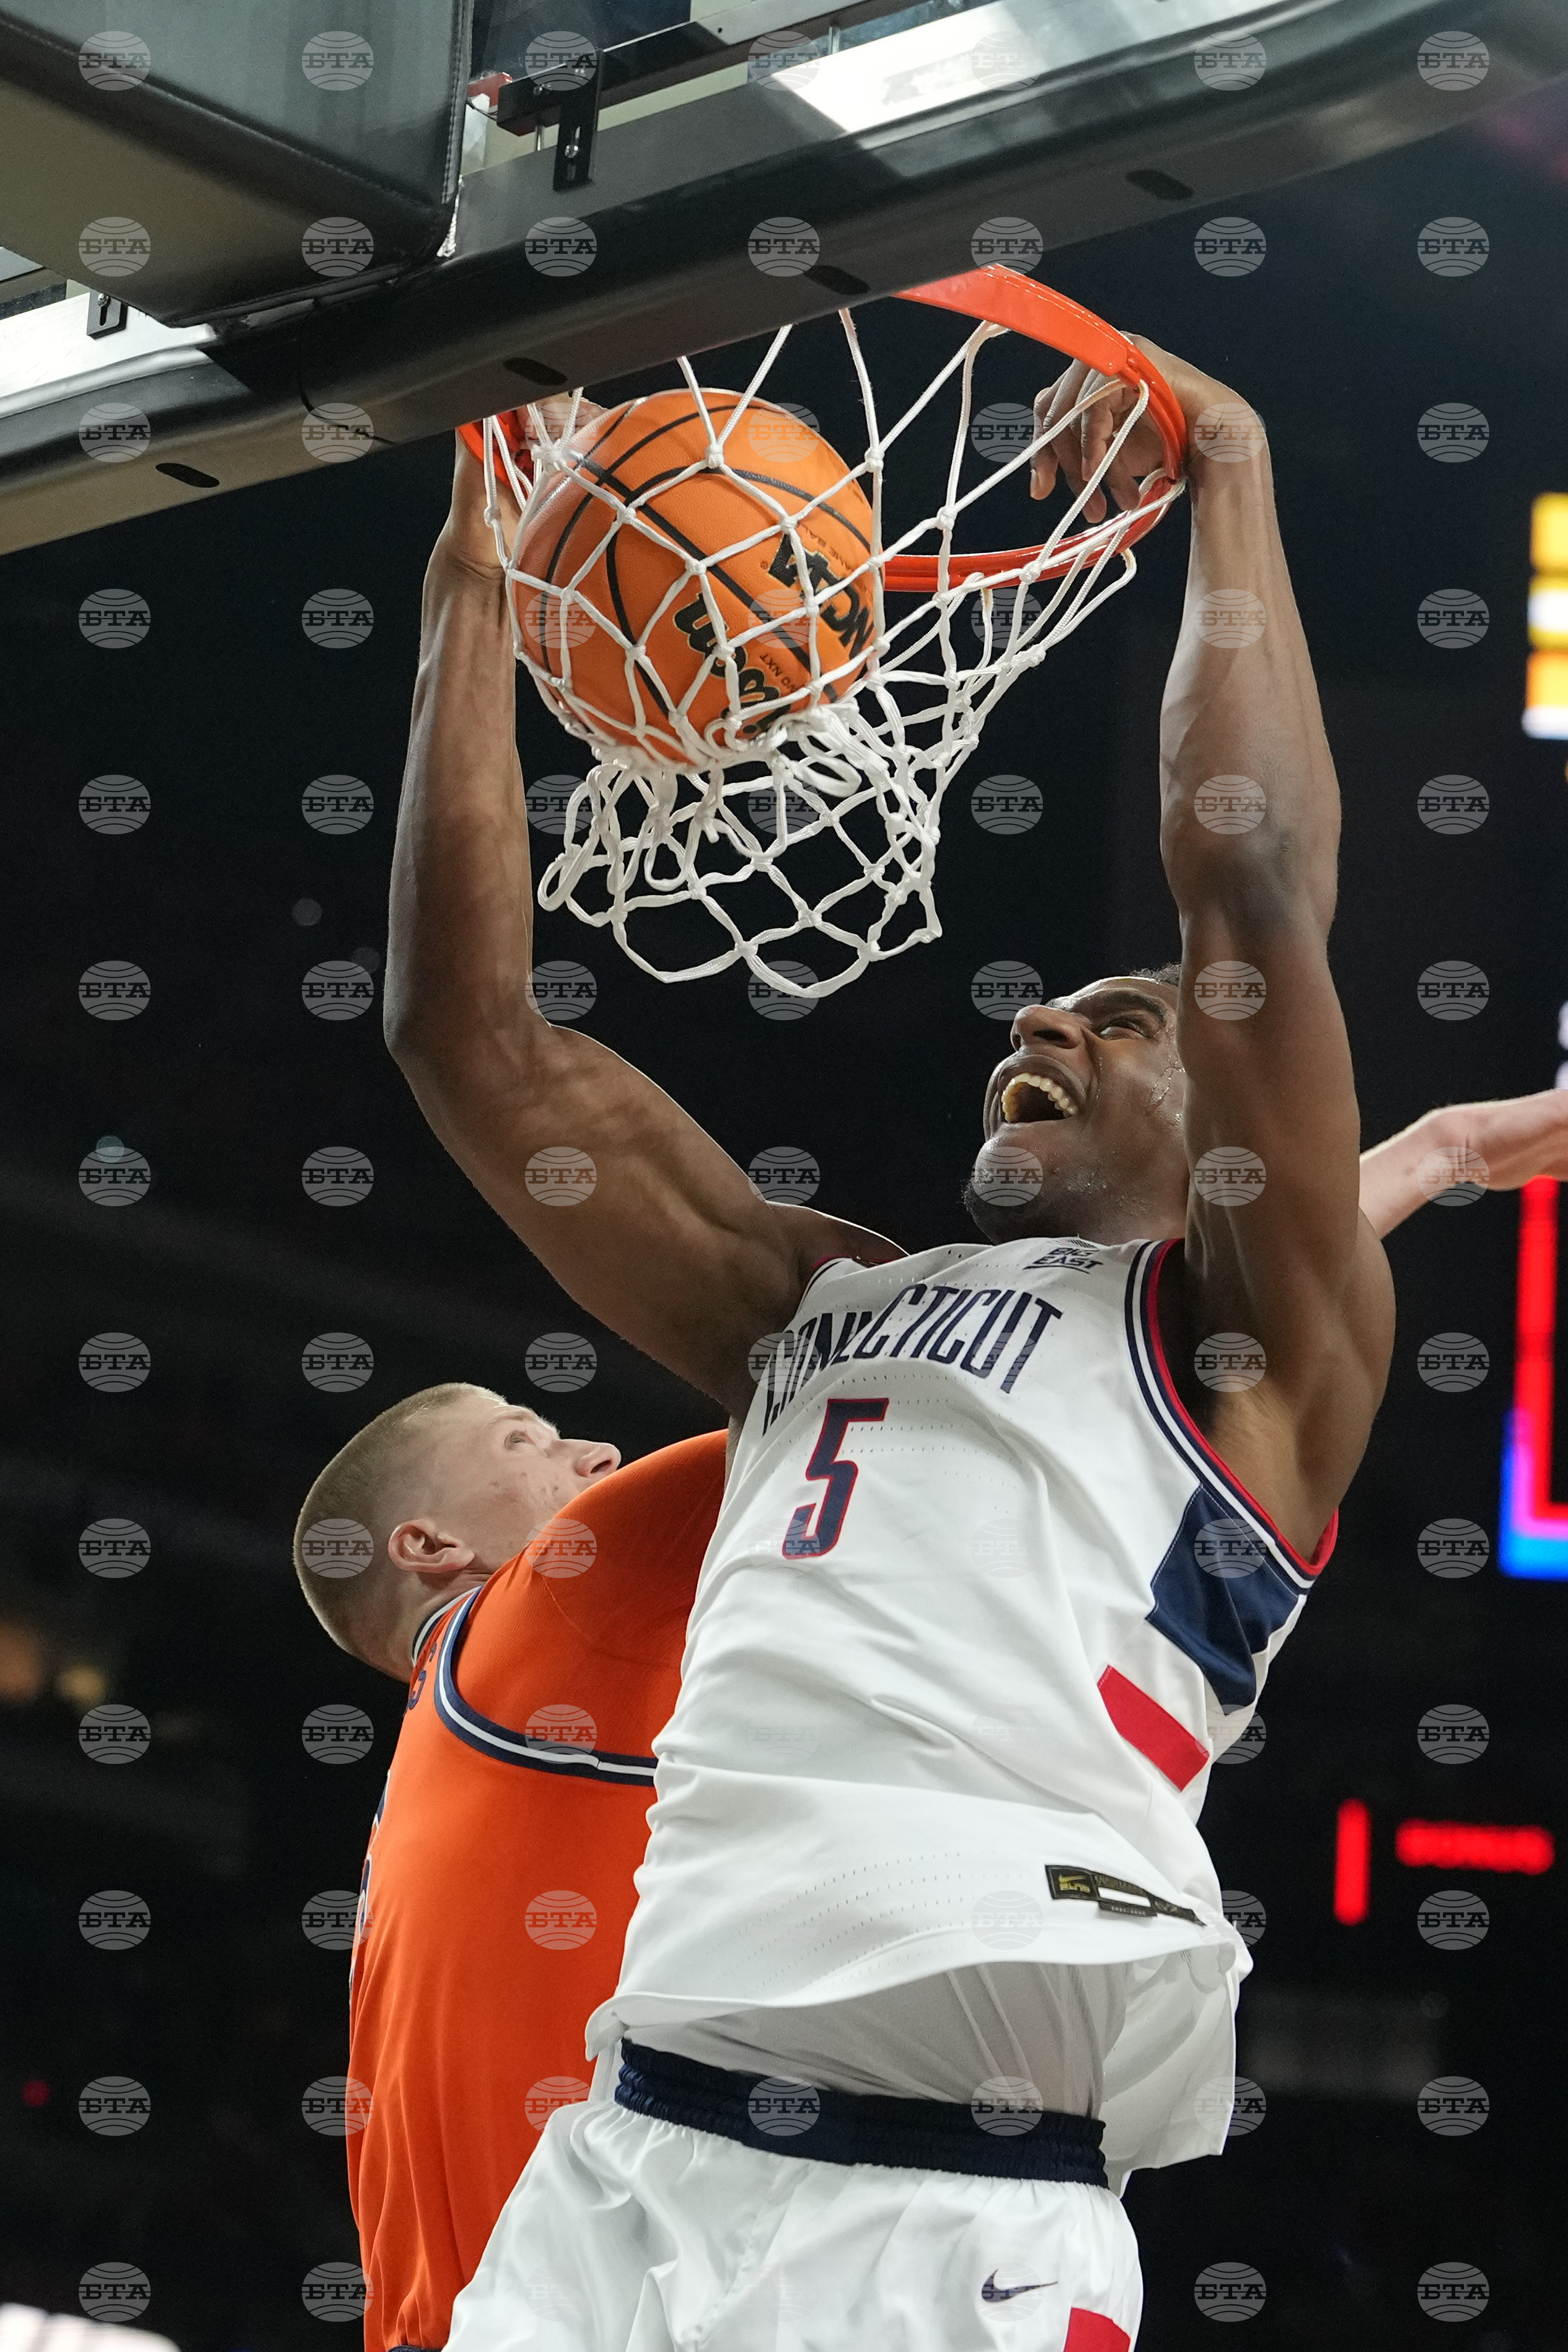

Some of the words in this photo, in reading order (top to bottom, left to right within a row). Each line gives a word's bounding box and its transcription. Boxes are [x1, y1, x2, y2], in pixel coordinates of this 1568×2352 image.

[769, 534, 875, 663] NCAA
[673, 593, 792, 734] ilson
[760, 653, 783, 677] NXT
[1033, 1256, 1104, 1269] EAST
[1047, 1248, 1099, 1257] BIG
[782, 1398, 889, 1559] 5
